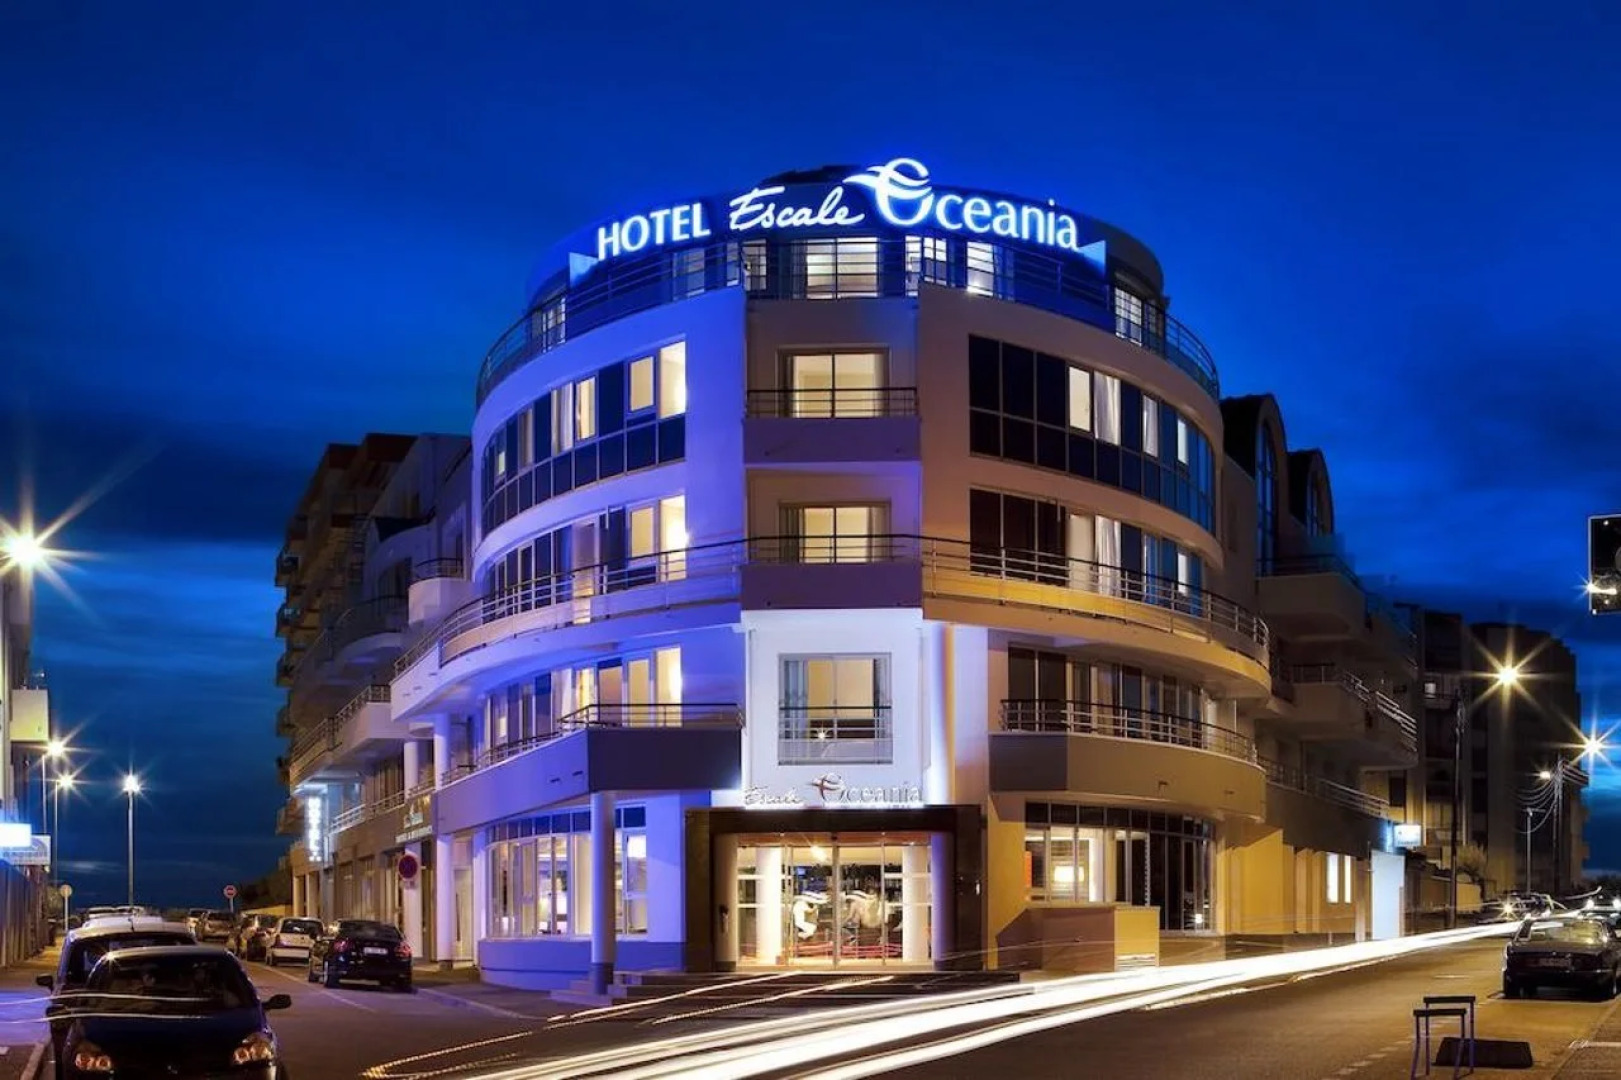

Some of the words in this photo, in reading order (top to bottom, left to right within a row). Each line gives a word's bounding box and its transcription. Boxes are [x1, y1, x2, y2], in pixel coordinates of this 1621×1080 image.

[597, 203, 710, 260] HOTEL
[728, 186, 864, 230] Escale
[844, 158, 1078, 252] Oceania
